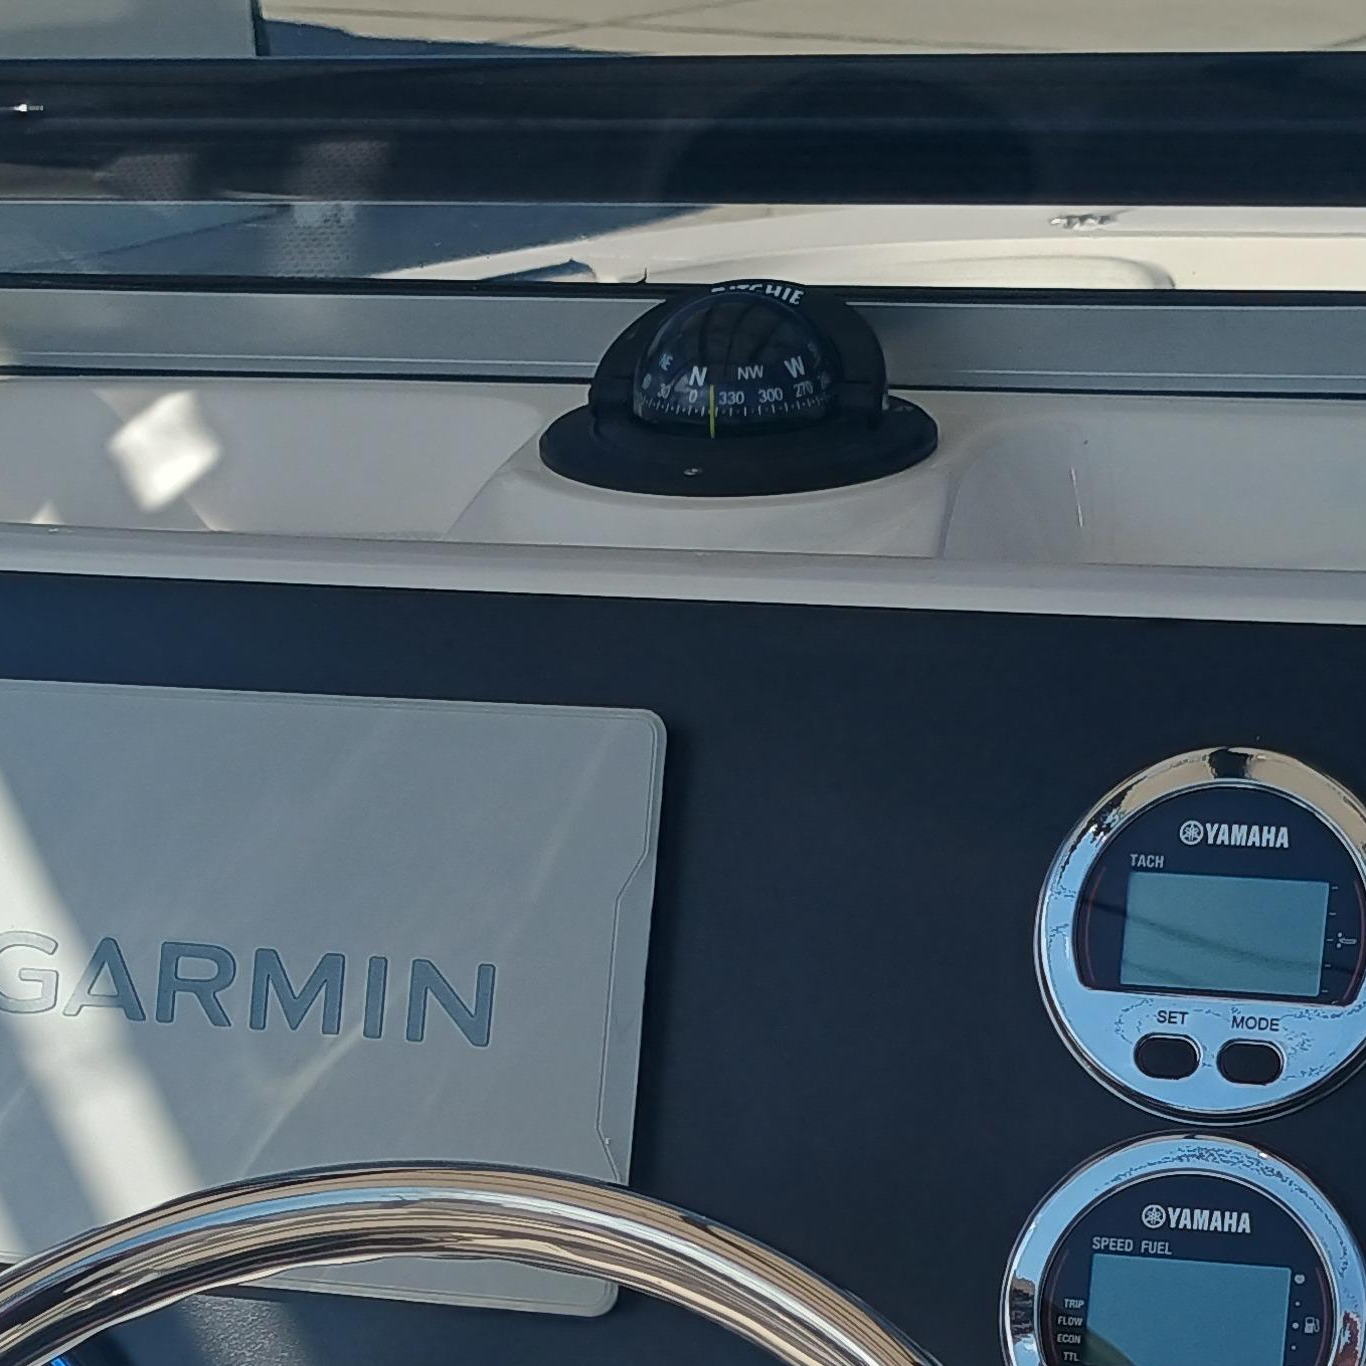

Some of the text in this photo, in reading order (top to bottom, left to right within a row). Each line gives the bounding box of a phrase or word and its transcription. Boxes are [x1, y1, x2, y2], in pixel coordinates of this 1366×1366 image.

[689, 366, 707, 387] N
[737, 365, 764, 381] NW
[784, 355, 806, 379] W
[719, 391, 745, 405] 330
[758, 387, 783, 402] 300
[793, 381, 813, 398] 270
[1205, 823, 1289, 848] YAMAHA
[1130, 854, 1164, 869] TACH
[1157, 1010, 1280, 1032] SET MODE
[1167, 1207, 1251, 1233] YAMAHA
[1092, 1236, 1173, 1256] SPEED FUEL
[1064, 1298, 1085, 1309] TRIP
[1057, 1315, 1083, 1327] FLOW
[1057, 1333, 1081, 1345] ECON
[1063, 1351, 1080, 1362] TTL
